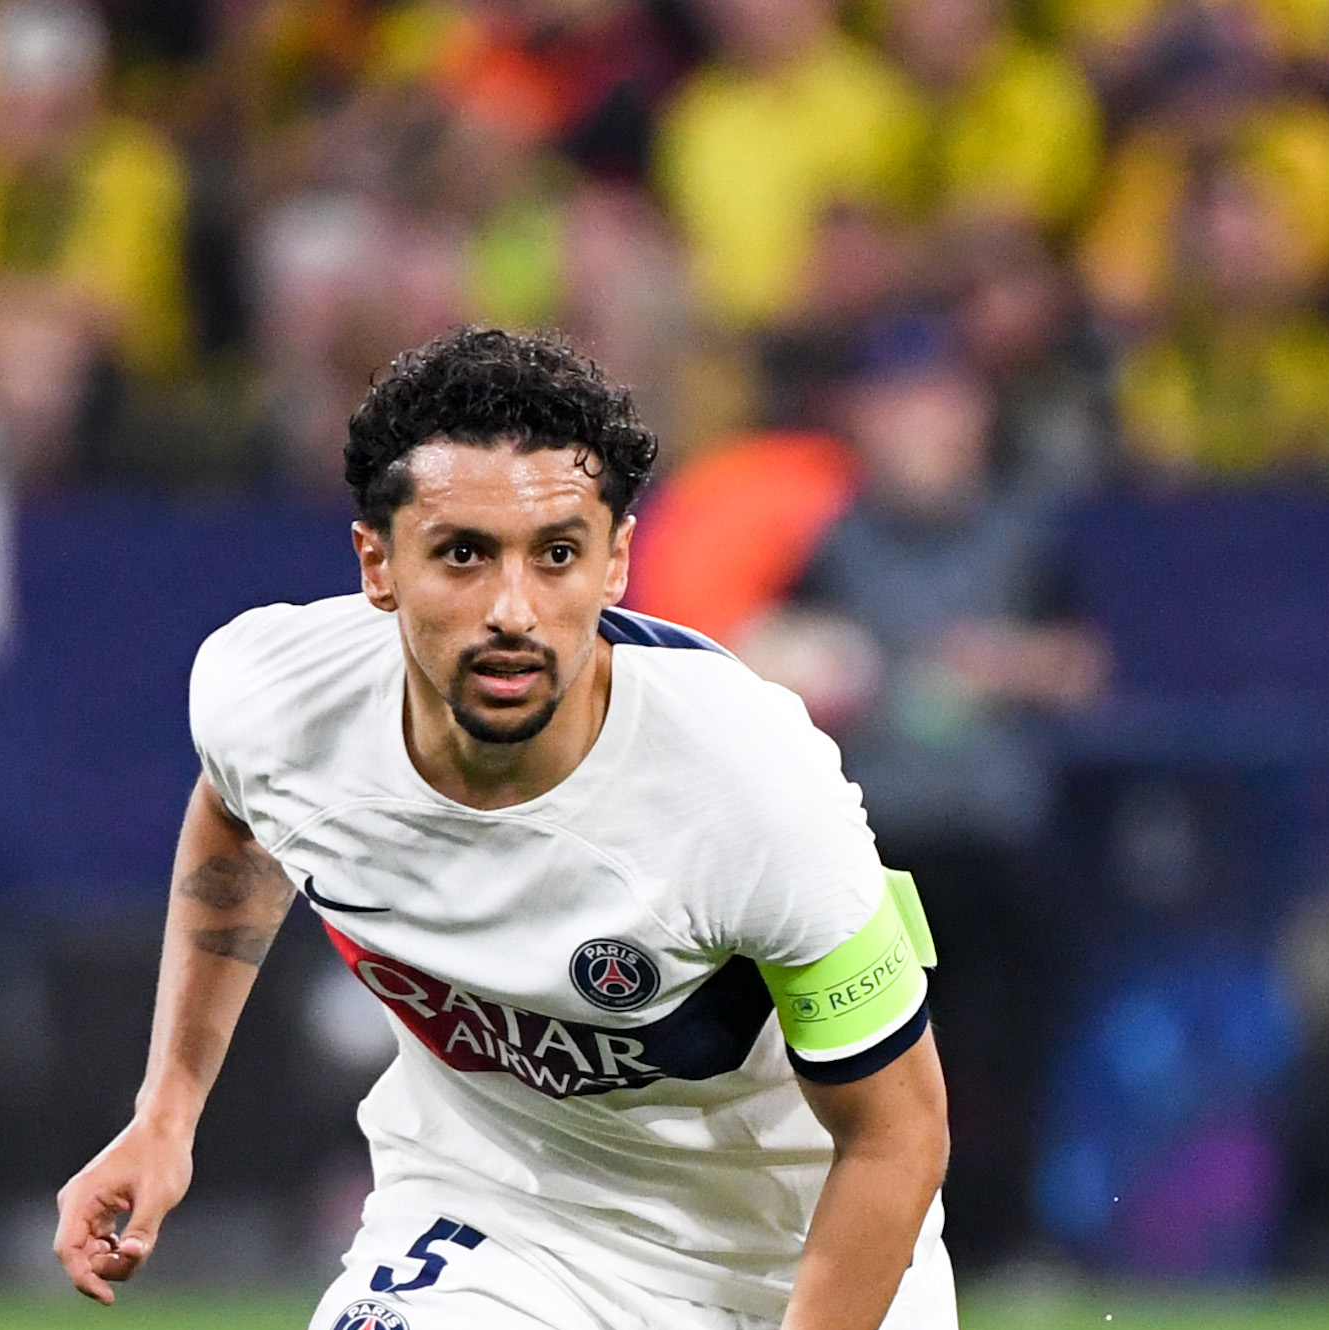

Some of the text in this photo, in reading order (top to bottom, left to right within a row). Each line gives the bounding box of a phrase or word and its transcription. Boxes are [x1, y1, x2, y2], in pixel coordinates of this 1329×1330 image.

[584, 945, 639, 964] PARIS
[828, 932, 909, 1010] RESPECT
[357, 960, 661, 1076] QATAR
[446, 1021, 667, 1094] AIRWA
[370, 1217, 487, 1292] 5
[347, 1304, 401, 1328] PARIS
